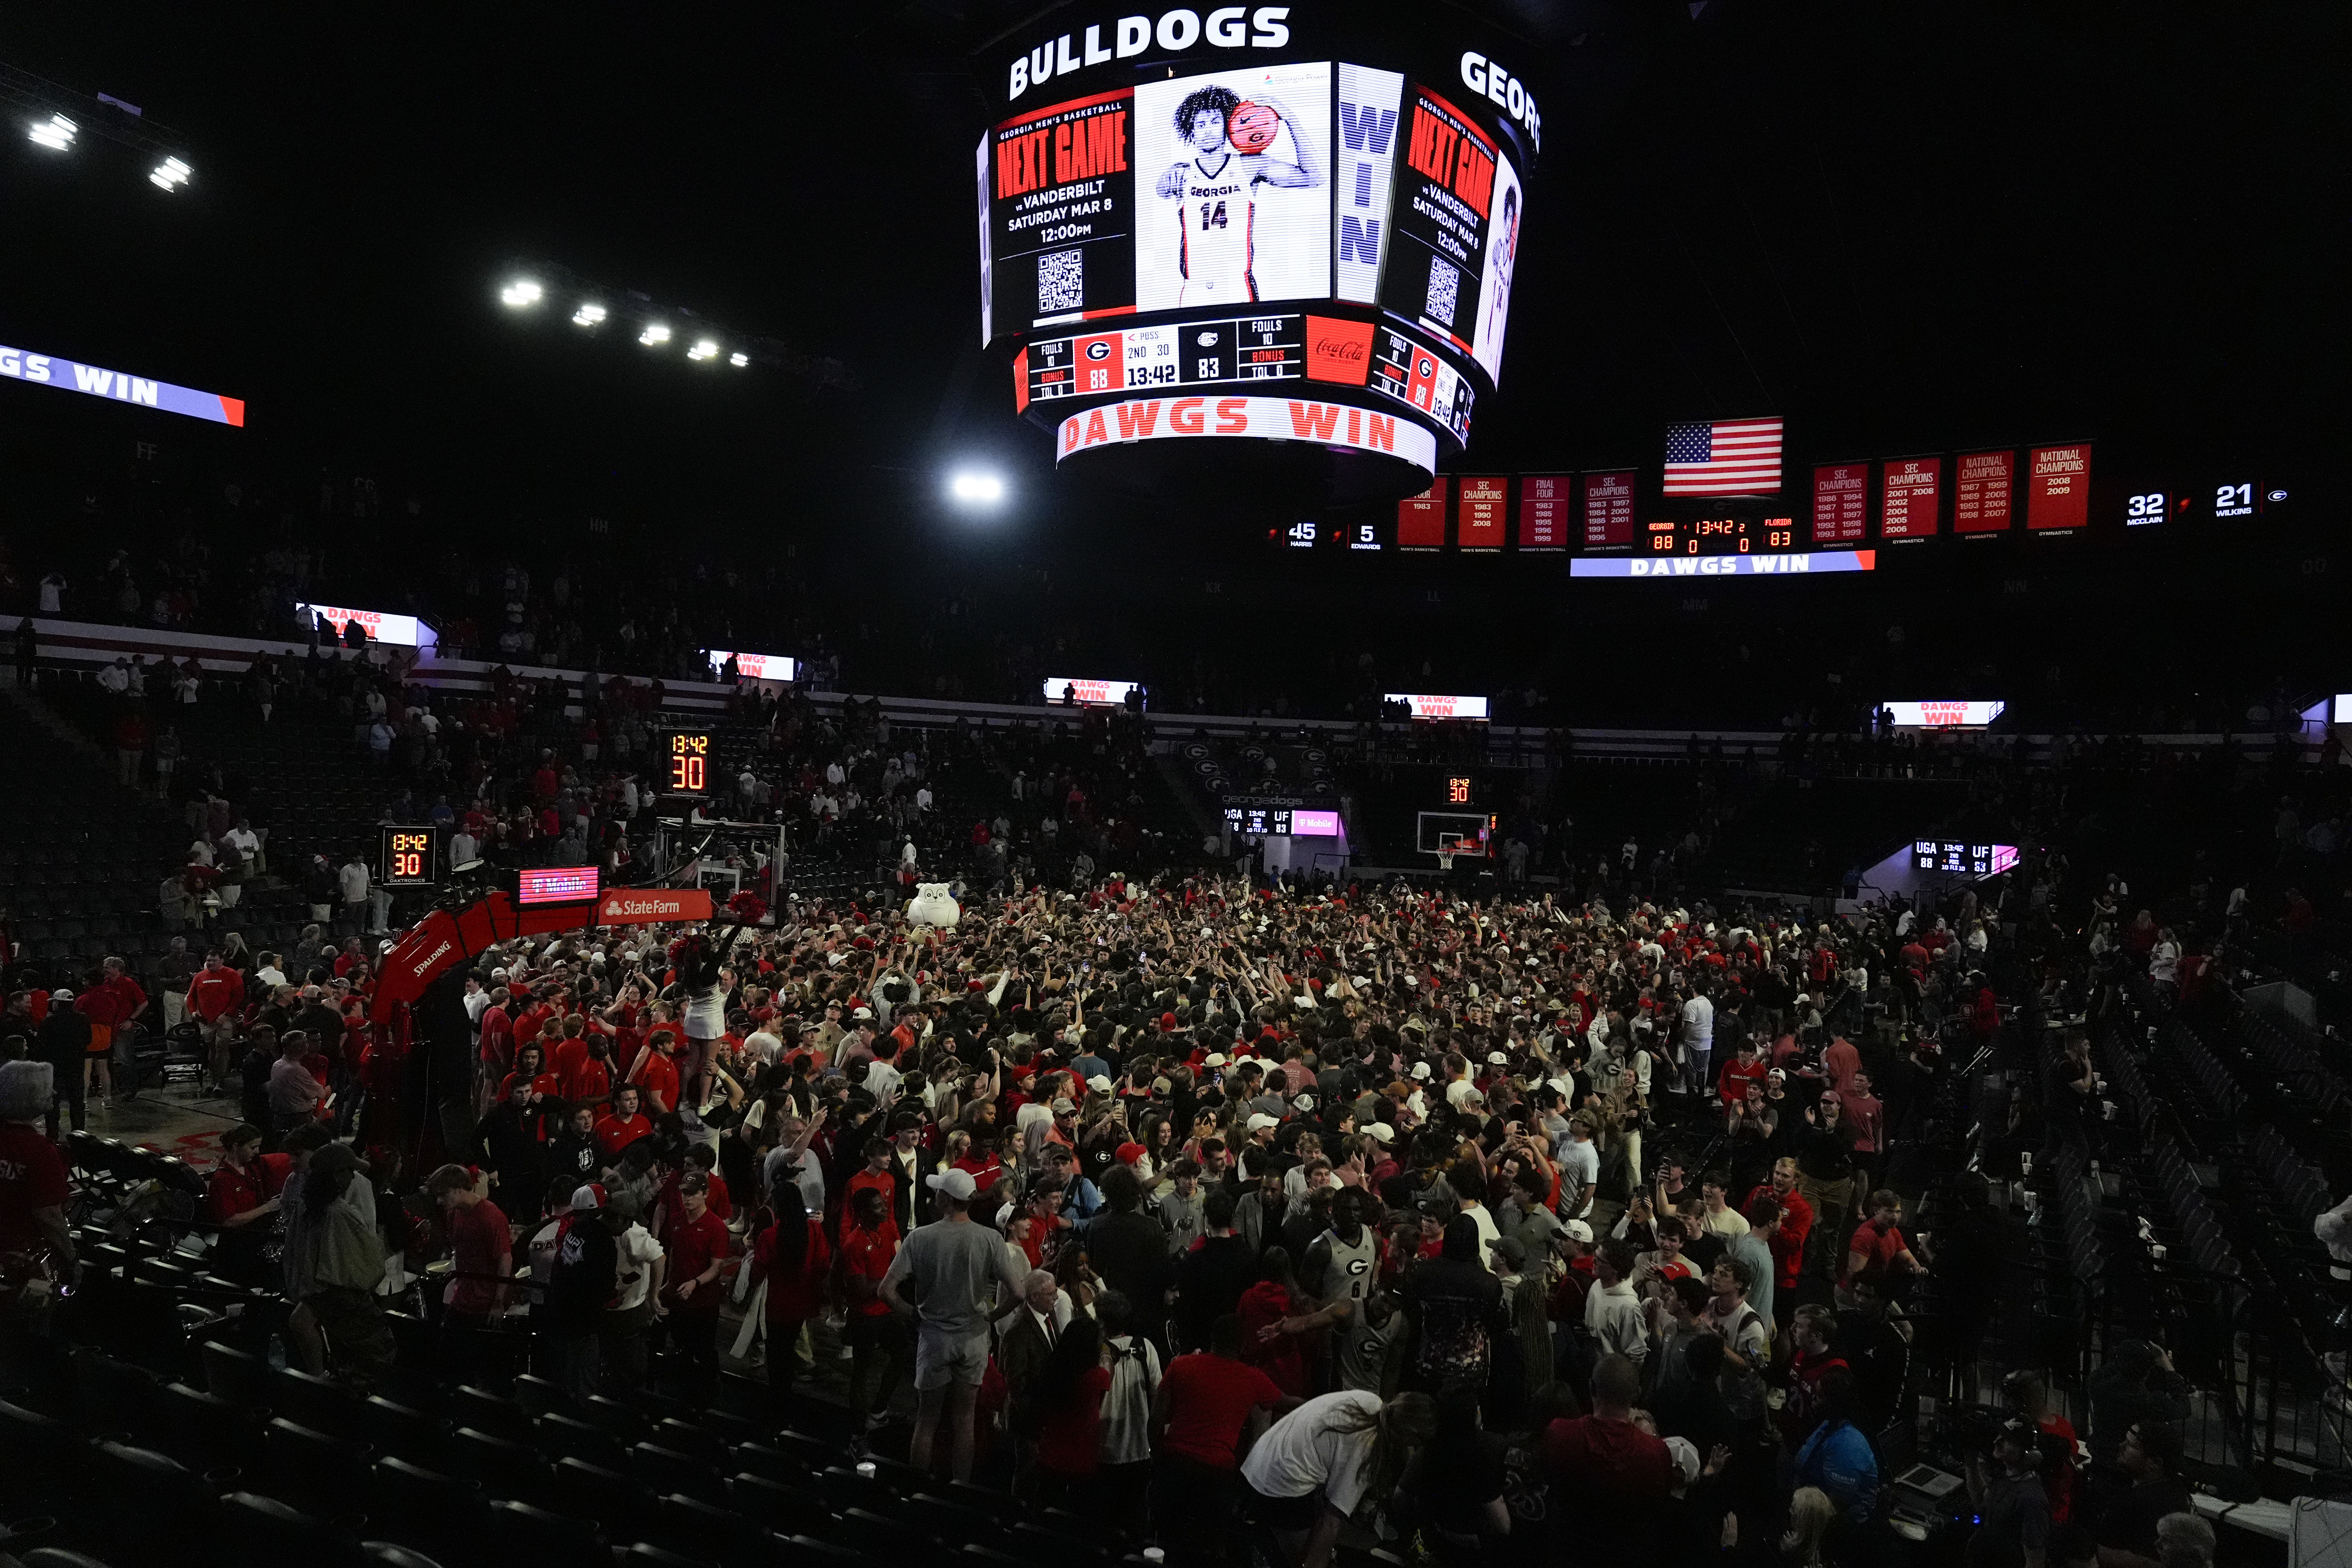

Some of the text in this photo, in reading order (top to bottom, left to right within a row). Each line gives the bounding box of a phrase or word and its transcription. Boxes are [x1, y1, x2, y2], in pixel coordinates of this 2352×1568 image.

[1010, 7, 1290, 101] BULLDOGS
[1000, 102, 1122, 140] GEORGIA MEN'S BASKETBALL
[1419, 98, 1494, 162] GEORGIA MEN'S BASKETBALL
[1408, 105, 1457, 188] NEXT
[998, 111, 1127, 200] NEXT GAME
[1191, 185, 1241, 197] GEORGIA
[1339, 103, 1401, 265] WIN
[1024, 180, 1105, 209] VANDERBILT
[1430, 184, 1478, 229] VANDERBILT
[1009, 198, 1112, 231] SATURDAY MAR 8
[1200, 201, 1228, 230] 14
[1413, 196, 1479, 250] SATURDAY MAR 8
[1438, 230, 1467, 262] 12:00PM
[1252, 320, 1282, 332] FOULS
[1140, 331, 1159, 341] POSS
[1263, 333, 1272, 345] 10
[1042, 343, 1063, 356] FOULS
[1390, 336, 1406, 352] FOULS
[1128, 344, 1169, 359] 2ND 30
[1252, 350, 1285, 363] BONUS
[1198, 358, 1219, 378] 83
[1384, 364, 1402, 381] BONUS
[1041, 370, 1064, 383] BONUS
[1090, 369, 1108, 389] 88
[1128, 365, 1175, 386] 13:42
[73, 364, 158, 406] WIN
[1415, 384, 1427, 407] 88
[1065, 398, 1395, 453] DAWGS WIN
[1966, 455, 2004, 468] NATIONAL
[2040, 449, 2080, 462] NATIONAL
[1905, 463, 1918, 473] SEC
[1962, 466, 2007, 479] CHAMPIONS
[2036, 460, 2084, 474] CHAMPIONS
[1603, 477, 1615, 486] SEC
[1835, 470, 1847, 479] SEC
[1889, 473, 1933, 485] CHAMPIONS
[2047, 477, 2071, 486] 2008
[1478, 481, 1489, 490] SEC
[1536, 479, 1554, 488] FINAL
[1819, 479, 1862, 491] CHAMPIONS
[1464, 490, 1502, 499] CHAMPIONS
[1537, 489, 1553, 498] FOUR
[1590, 486, 1628, 497] CHAMPIONS
[2047, 487, 2070, 495] 2009
[2216, 483, 2251, 508] 21
[2128, 494, 2163, 516] 32
[2216, 507, 2252, 517] WILKINS
[1696, 520, 1733, 534] 13:42
[1739, 523, 1745, 532] 2
[2127, 516, 2163, 526] MCCLAIN
[1289, 523, 1315, 539] 45
[1361, 525, 1374, 542] 5
[1654, 532, 1790, 553] 88 0 0 83
[1630, 555, 1809, 575] DAWGS WIN
[328, 608, 381, 623] DAWGS
[1071, 680, 1110, 689] DAWGS
[1074, 689, 1106, 701] WIN
[1420, 705, 1453, 715] WIN
[1924, 712, 1963, 724] WIN
[673, 735, 708, 754] 13:42
[672, 756, 703, 789] 30
[1450, 779, 1470, 787] 13:42
[1450, 787, 1467, 801] 30
[1274, 811, 1289, 822] UF
[1307, 818, 1332, 828] Mobile
[1276, 824, 1286, 833] 83
[393, 834, 427, 851] 13:42
[1916, 842, 1937, 854] UGA
[1973, 846, 1989, 858] UF
[395, 854, 419, 875] 30
[1920, 857, 1933, 868] 88
[546, 877, 586, 893] Mobile
[413, 940, 452, 977] SPALDING
[1351, 1281, 1361, 1298] 6
